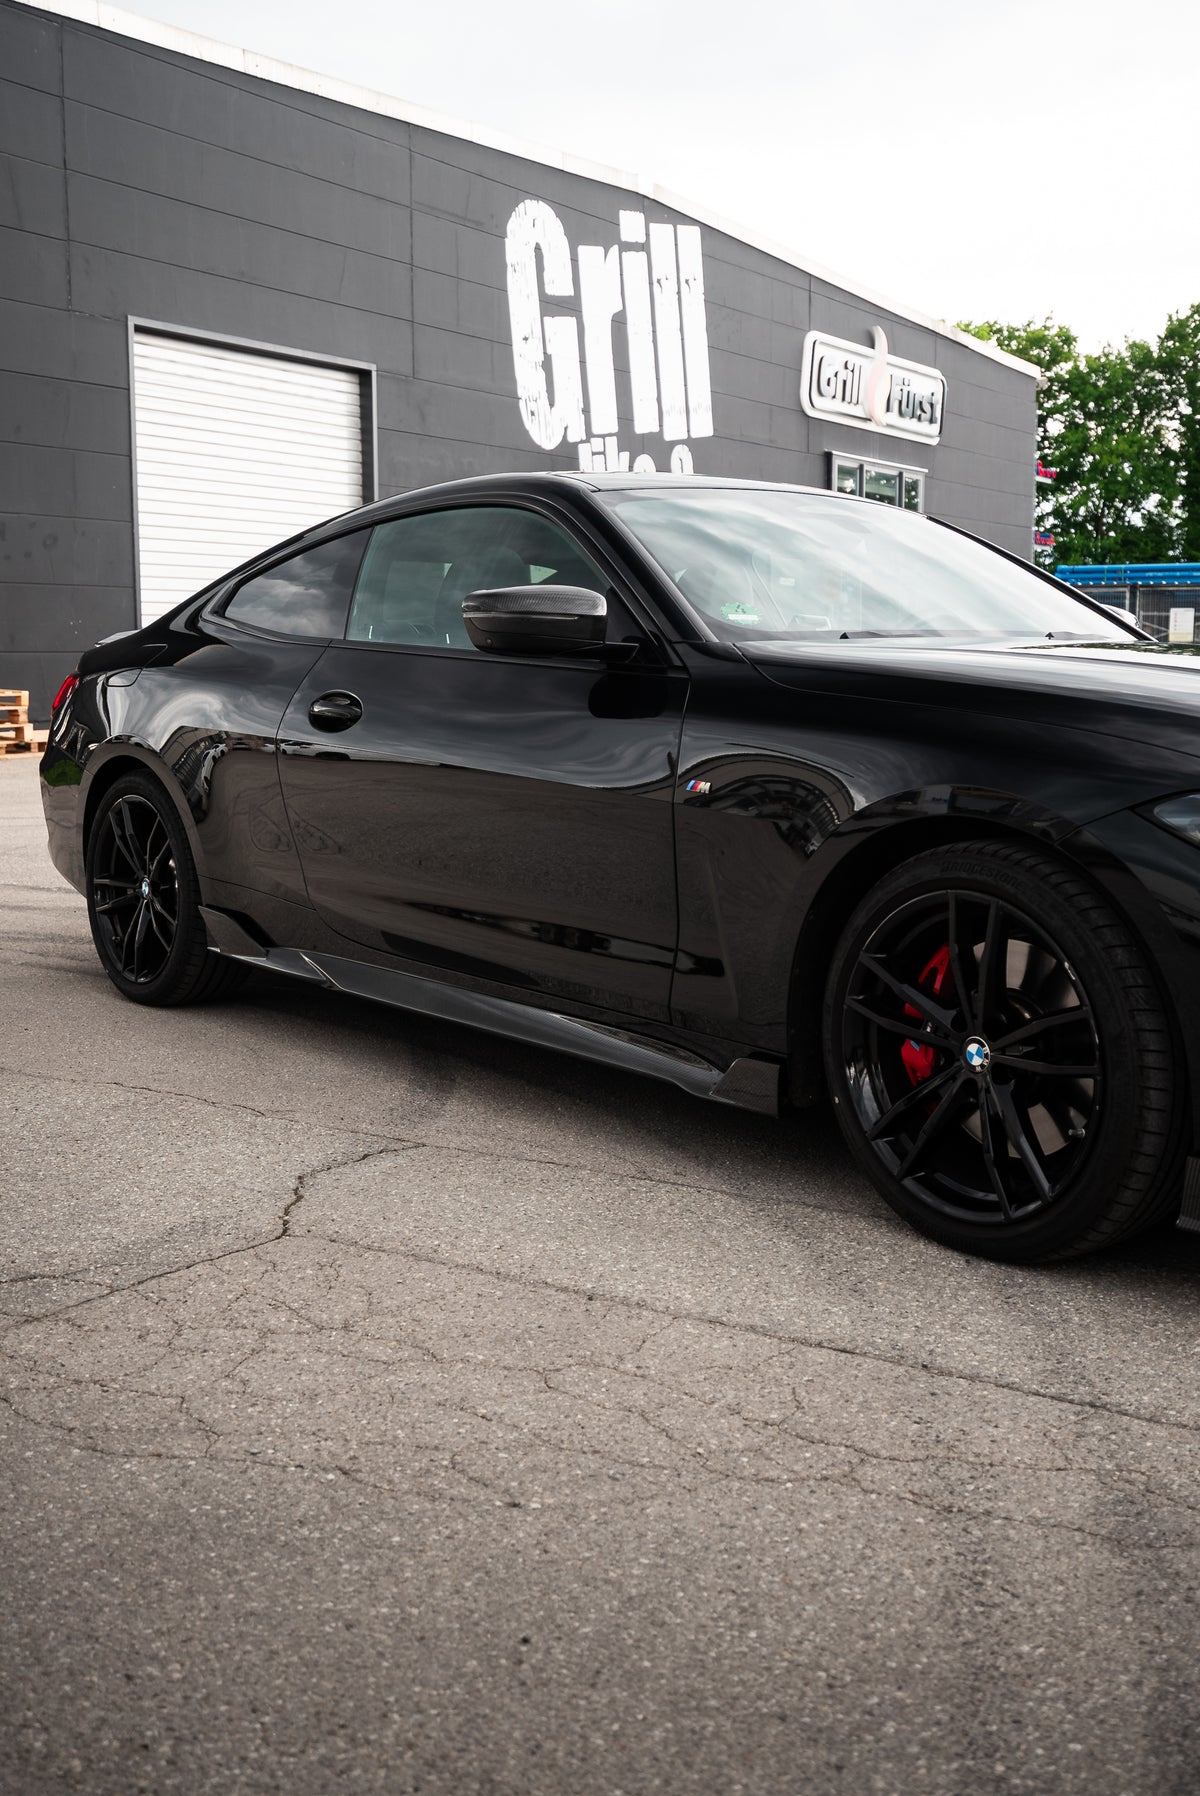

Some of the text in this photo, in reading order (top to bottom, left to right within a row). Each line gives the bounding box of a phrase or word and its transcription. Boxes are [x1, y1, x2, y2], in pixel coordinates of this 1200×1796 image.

[505, 199, 714, 450] Grill
[818, 353, 938, 424] Grill Fürst
